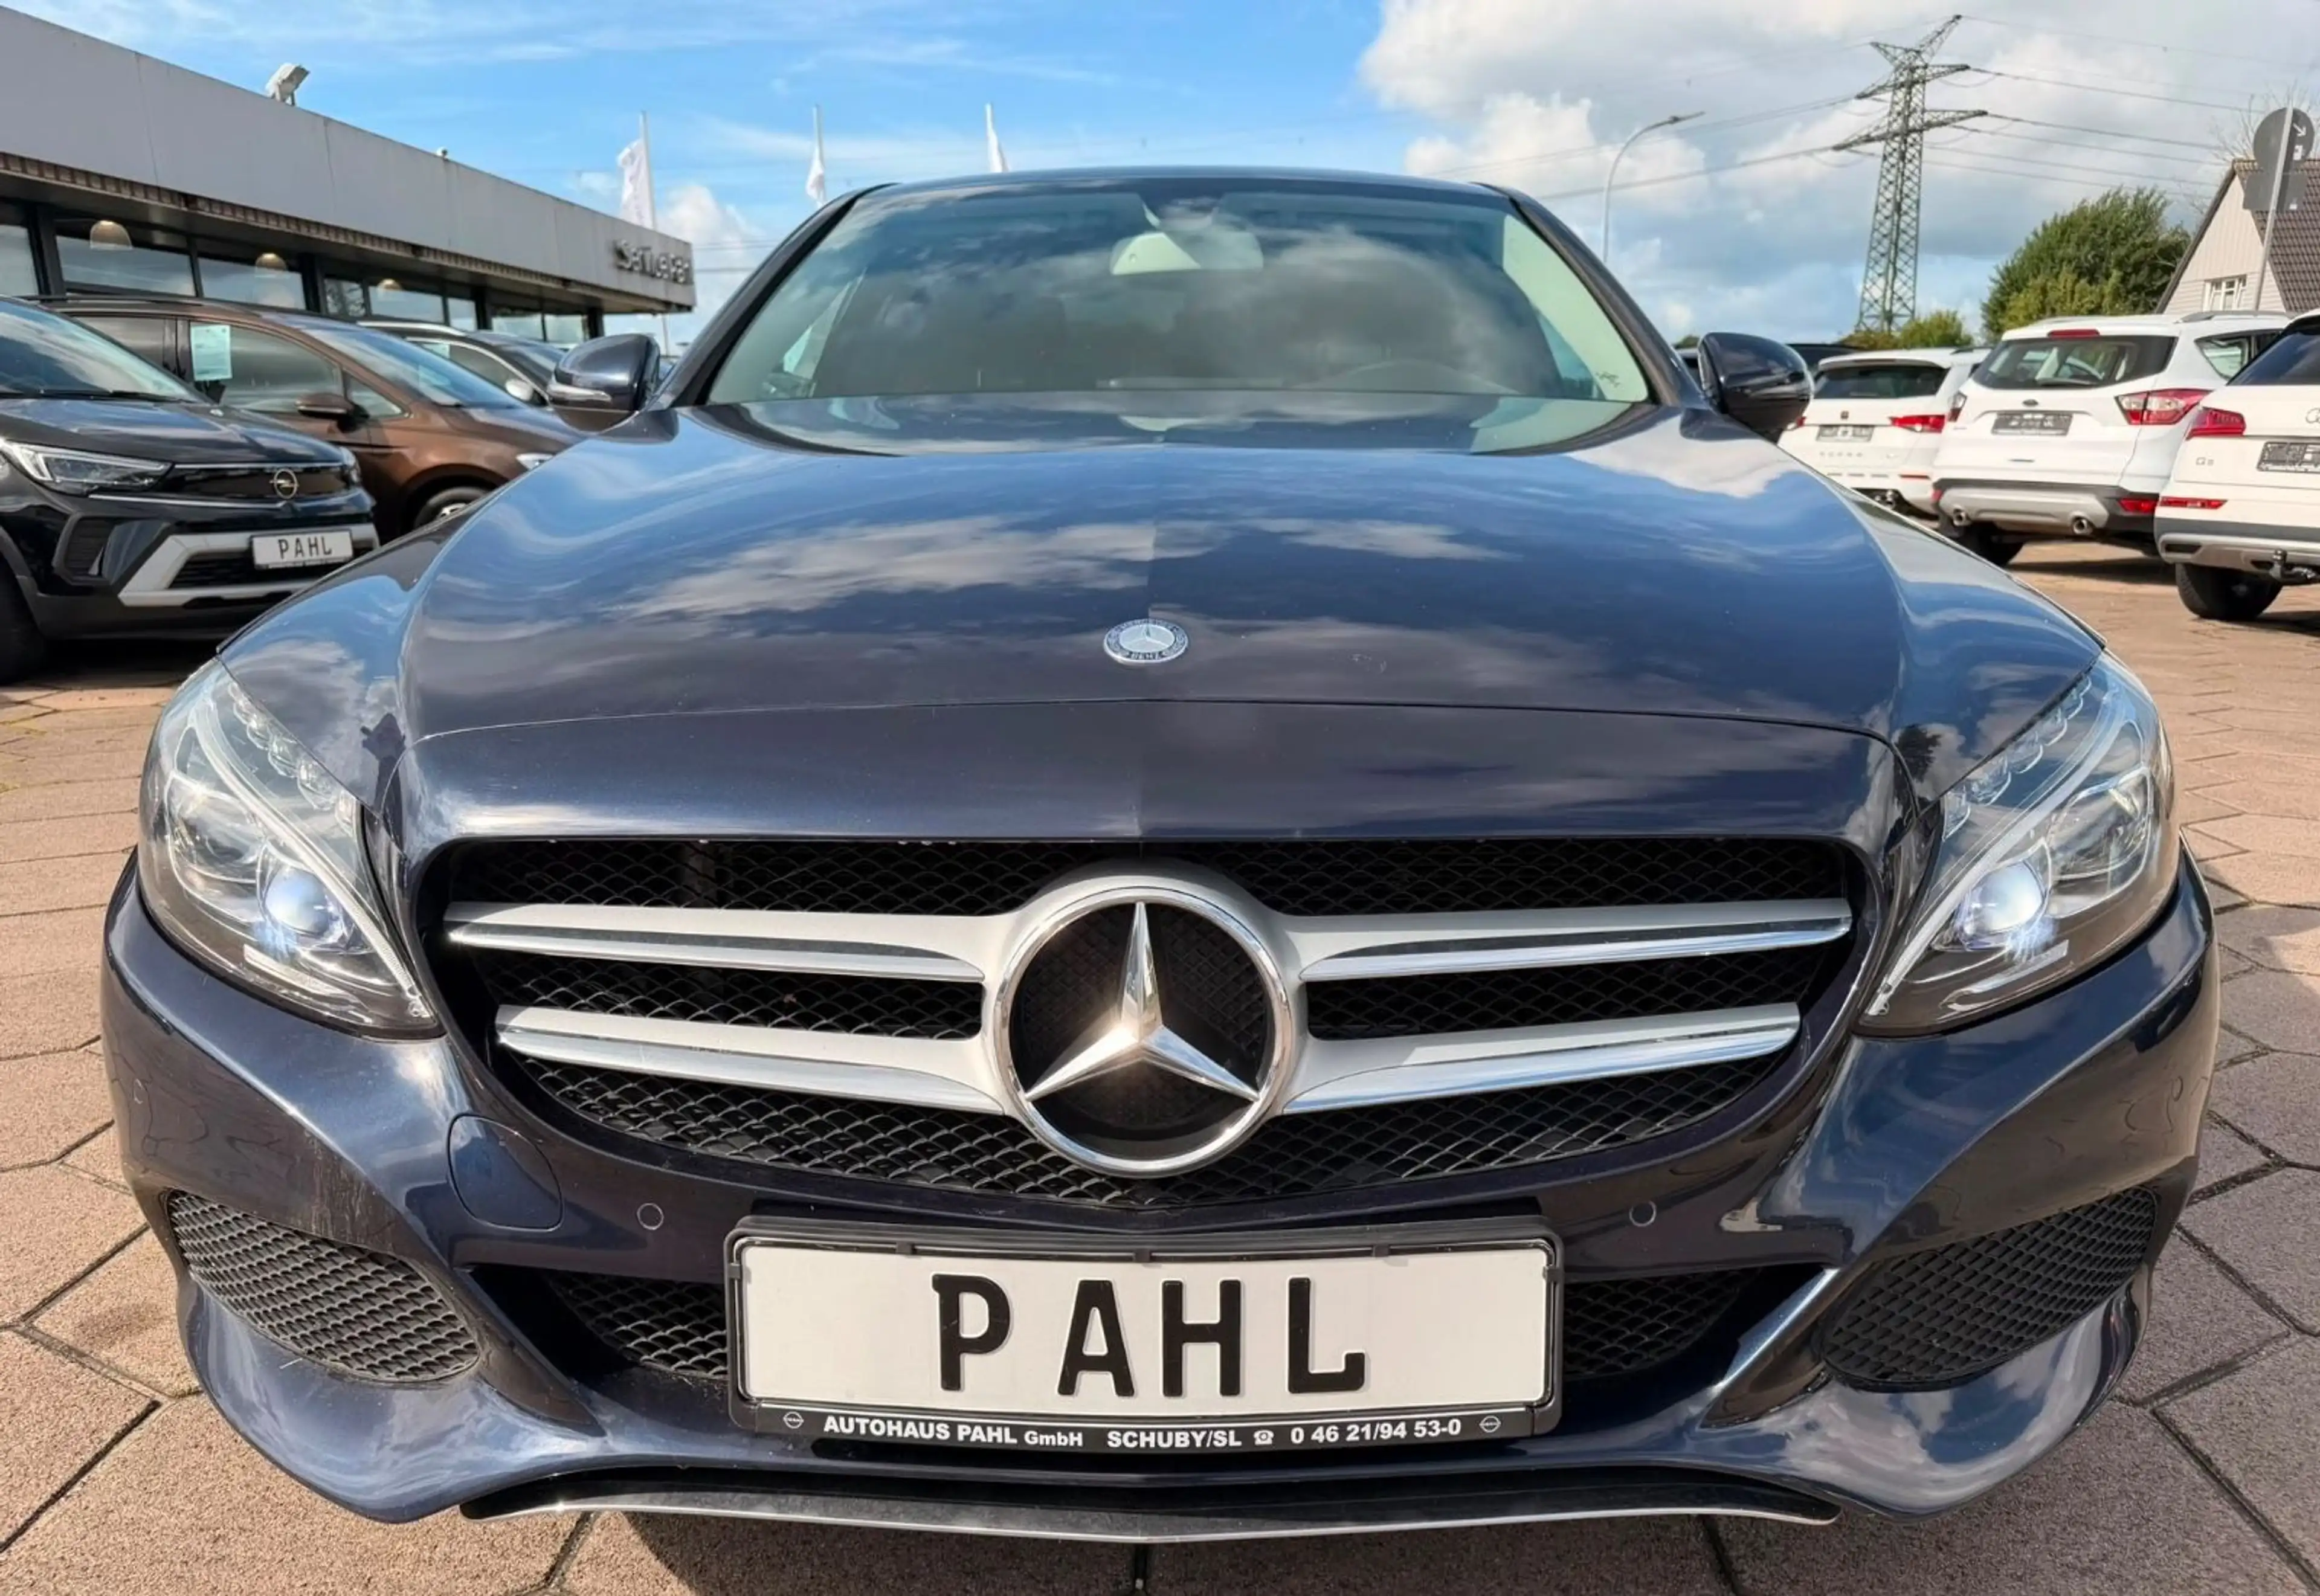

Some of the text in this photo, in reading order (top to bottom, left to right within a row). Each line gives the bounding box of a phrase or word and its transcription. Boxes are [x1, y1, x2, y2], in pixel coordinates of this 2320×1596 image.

[278, 536, 332, 559] PAHL
[932, 1273, 1366, 1397] PAHL
[823, 1415, 1462, 1449] AUTOHAUS PAHL GmbH SCHUBY/SL 0 46 21/94 53-0
